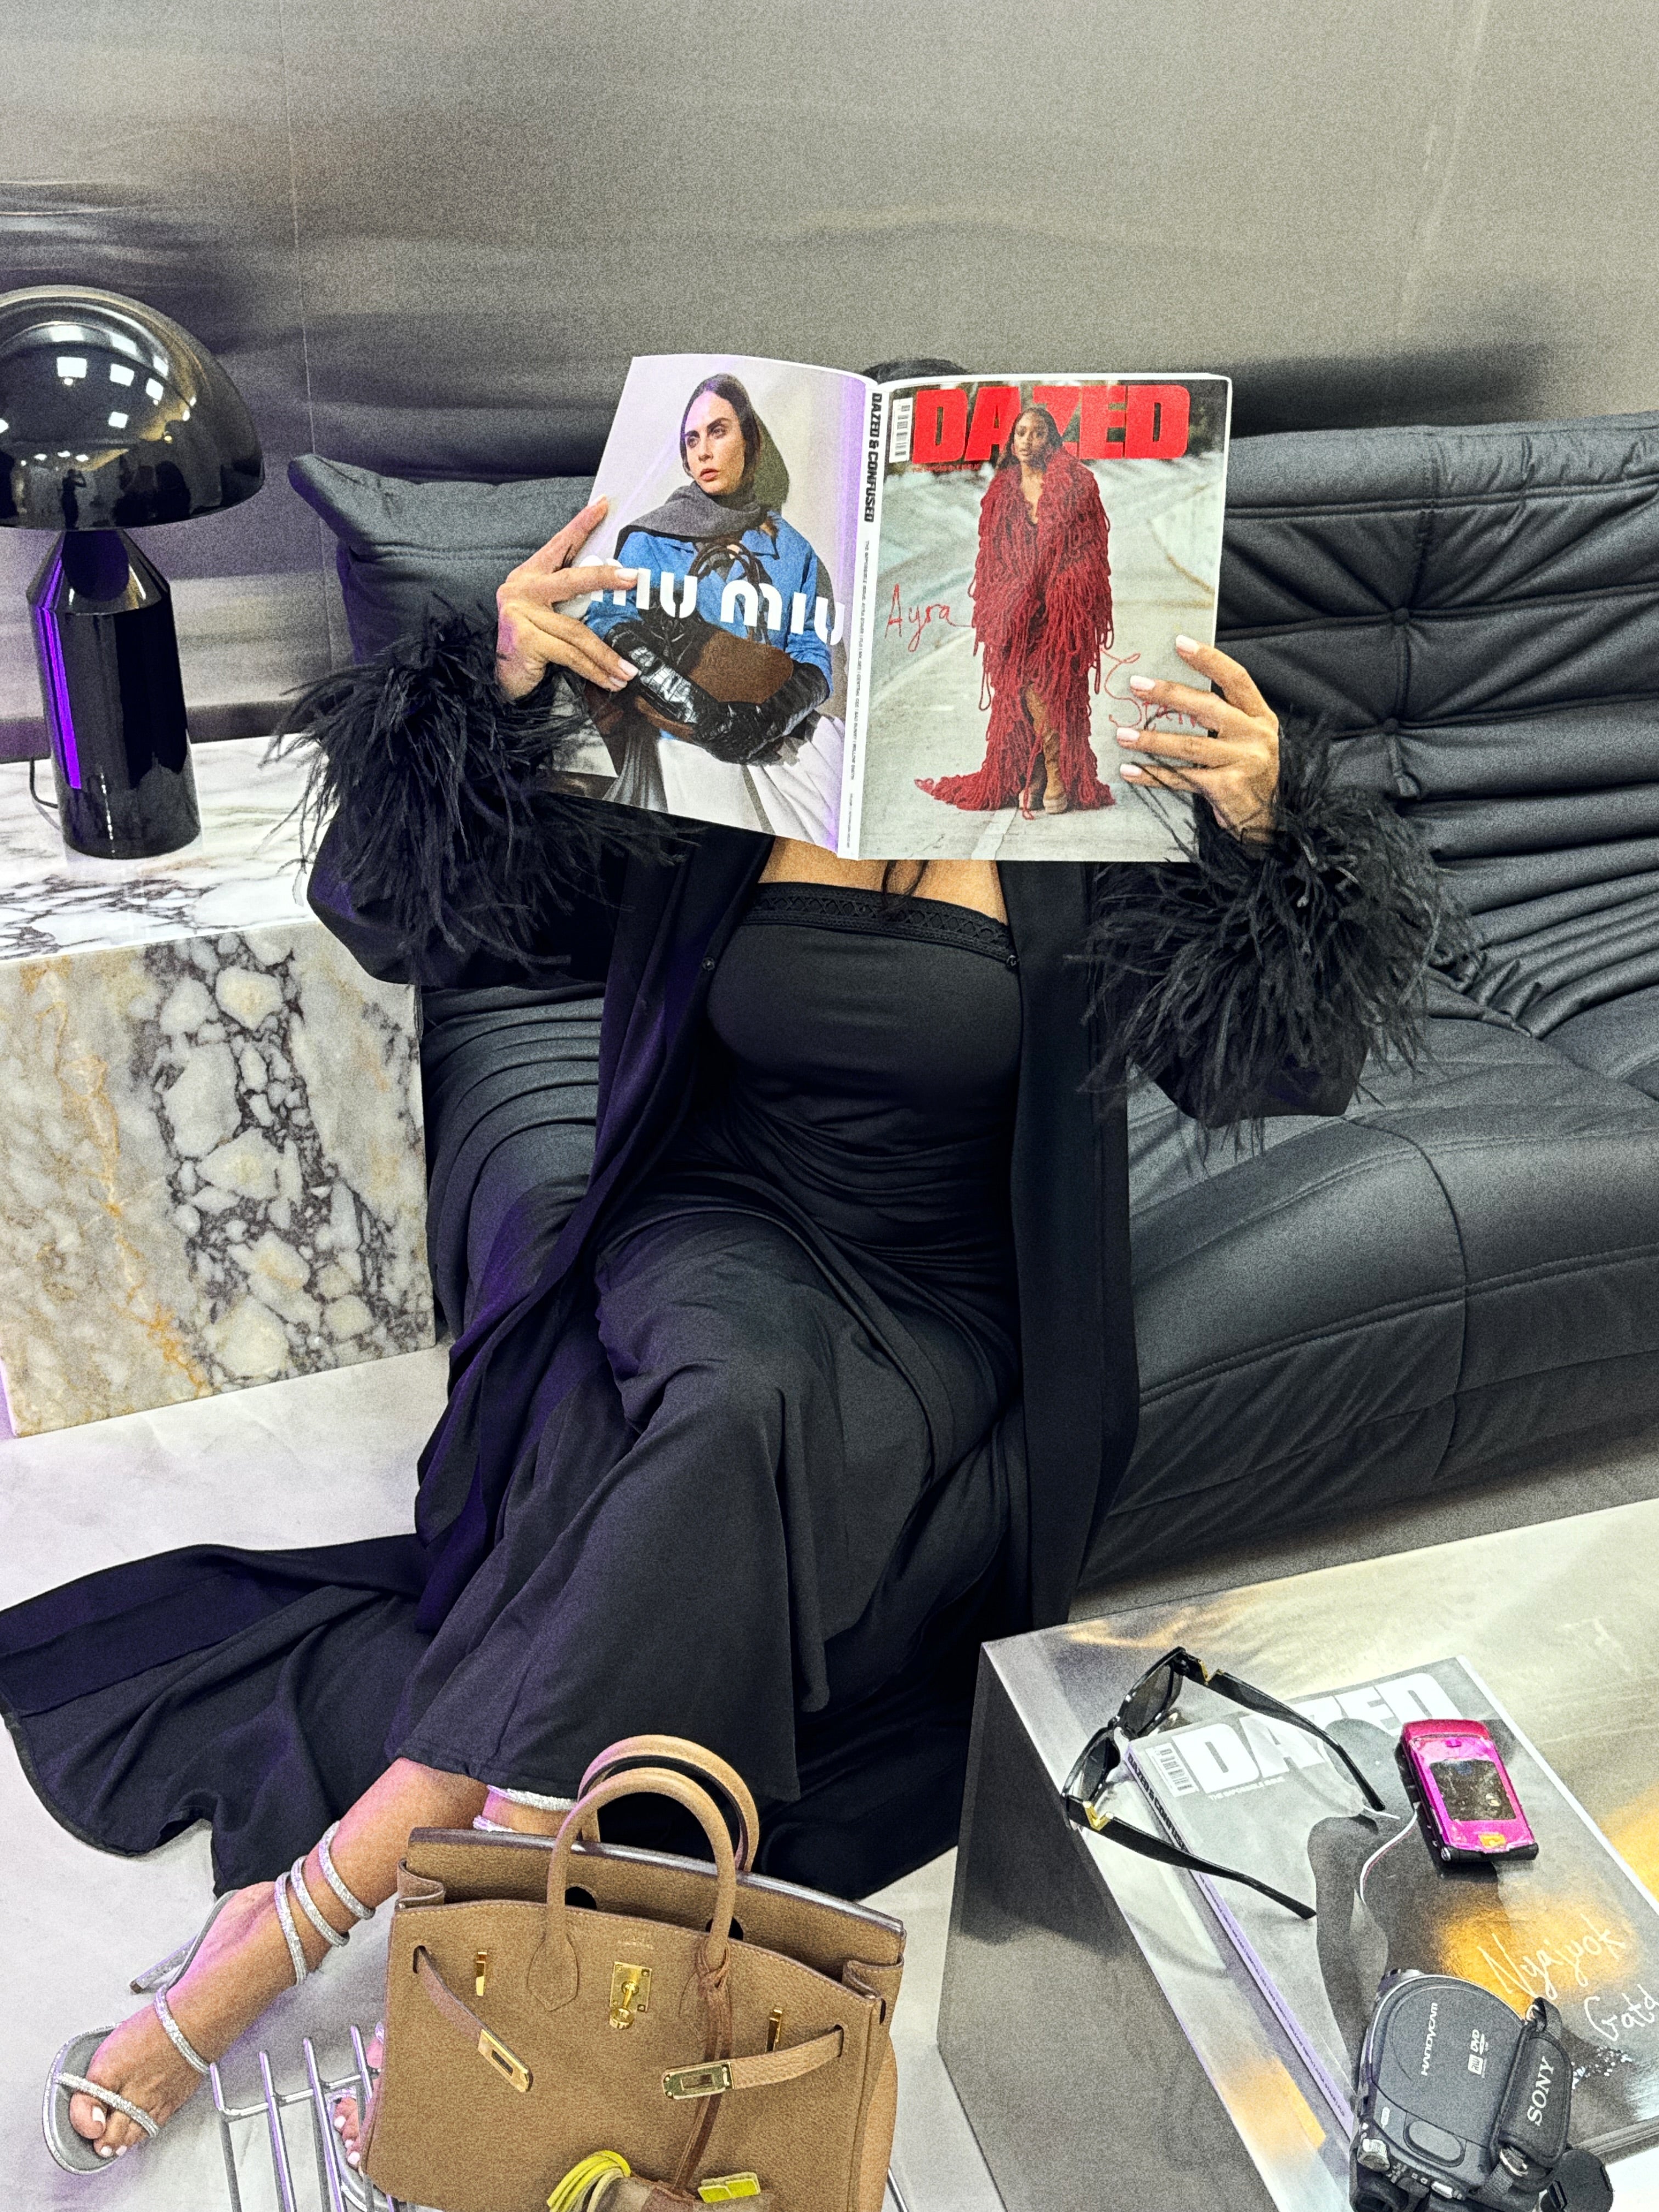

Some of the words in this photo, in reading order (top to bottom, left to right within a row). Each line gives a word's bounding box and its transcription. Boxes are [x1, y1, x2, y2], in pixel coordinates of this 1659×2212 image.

[868, 439, 879, 449] &
[870, 393, 882, 437] DAZED
[912, 385, 1190, 464] DAZED
[864, 450, 879, 522] CONFUSED
[720, 579, 845, 646] miu
[884, 583, 955, 653] Ayra
[1421, 2002, 1438, 2075] HANDYCAM
[1470, 2029, 1480, 2053] DVD
[1527, 2056, 1554, 2126] SONY
